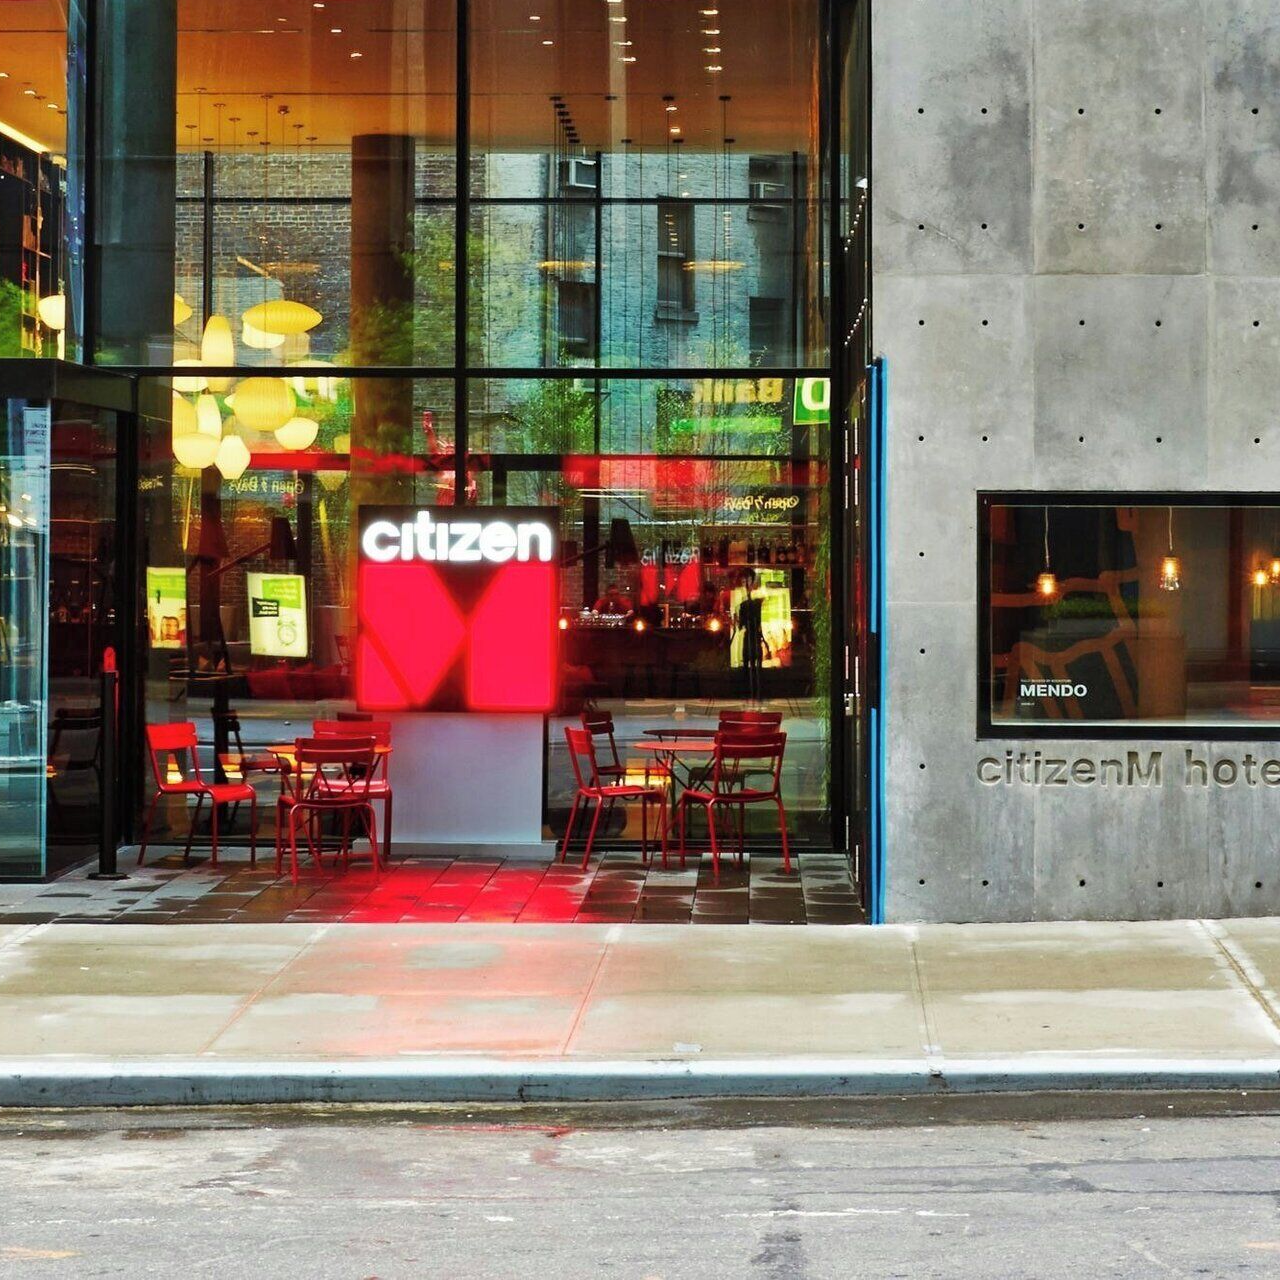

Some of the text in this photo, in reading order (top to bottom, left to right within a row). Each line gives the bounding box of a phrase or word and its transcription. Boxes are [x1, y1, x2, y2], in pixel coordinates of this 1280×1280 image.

[362, 510, 552, 562] citizen
[1020, 684, 1088, 697] MENDO
[975, 749, 1163, 788] citizenM
